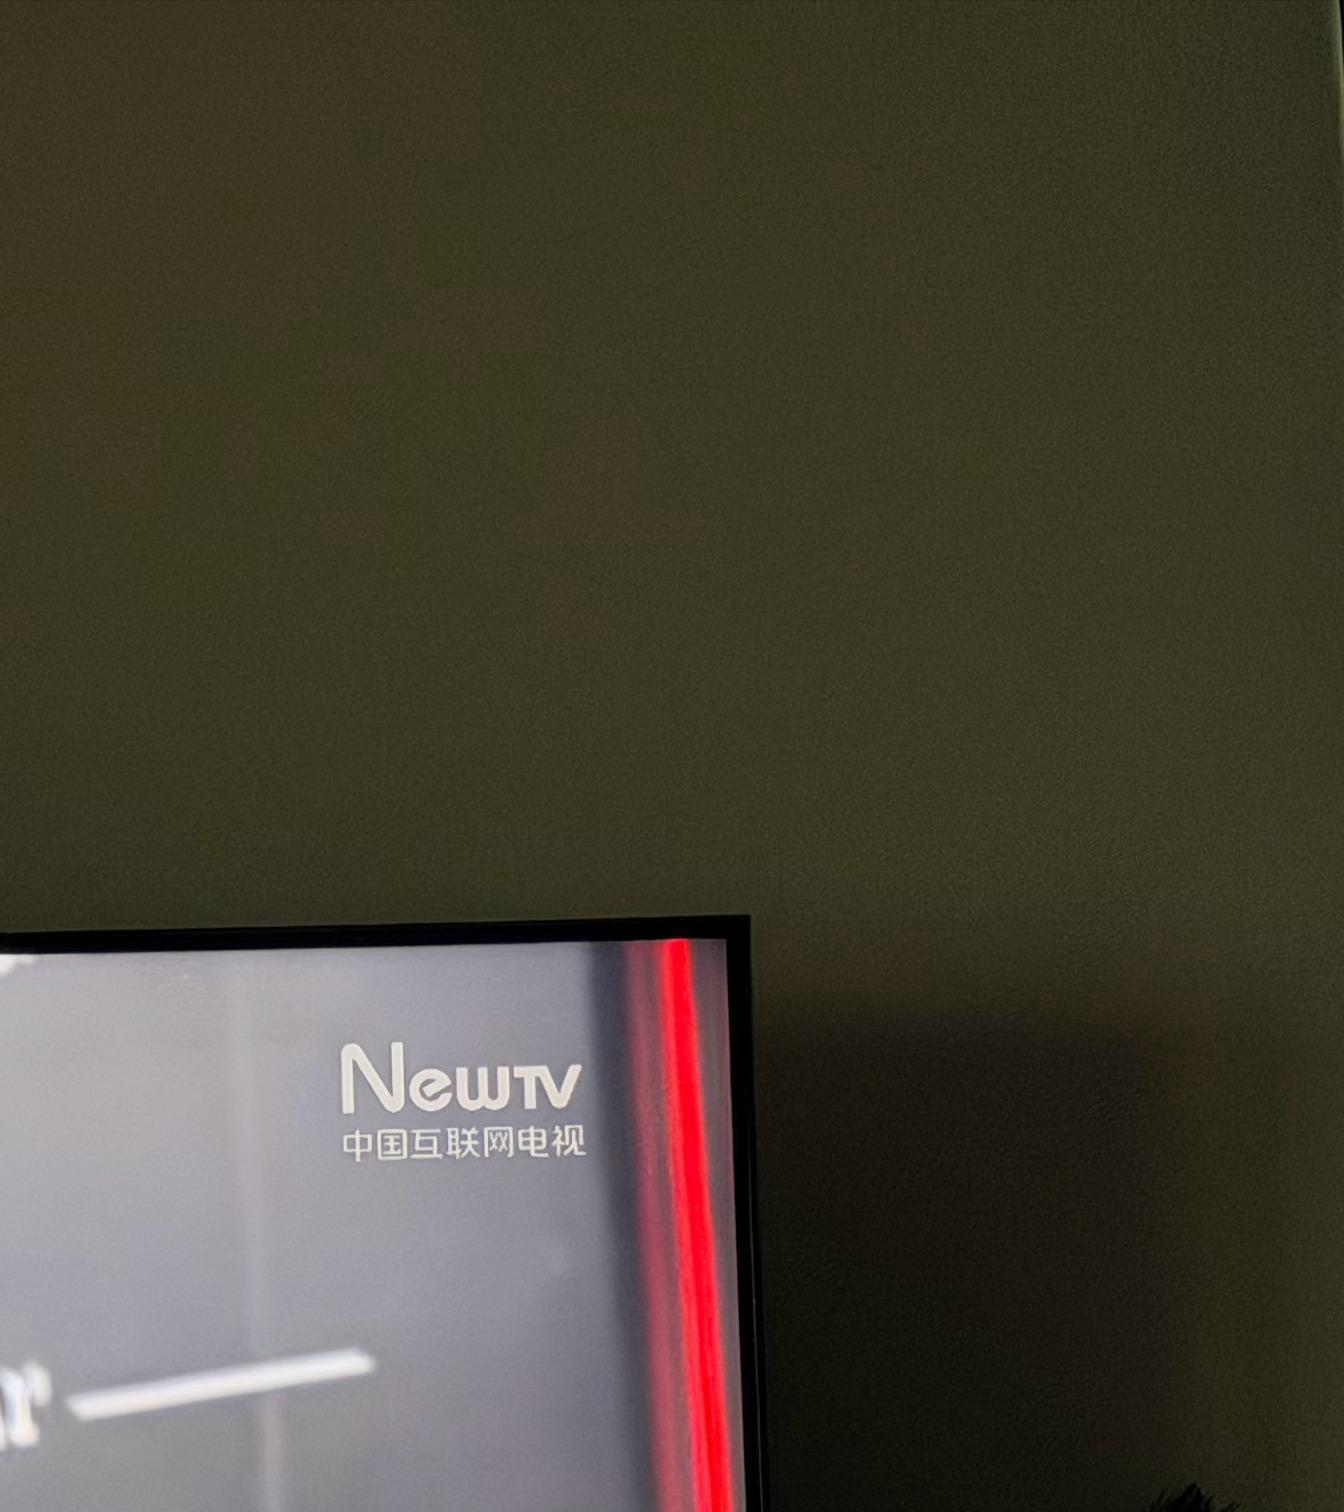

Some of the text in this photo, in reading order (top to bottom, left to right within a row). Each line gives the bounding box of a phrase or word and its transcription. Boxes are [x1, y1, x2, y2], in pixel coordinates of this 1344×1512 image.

[342, 1124, 588, 1162] 中国互联网电视
